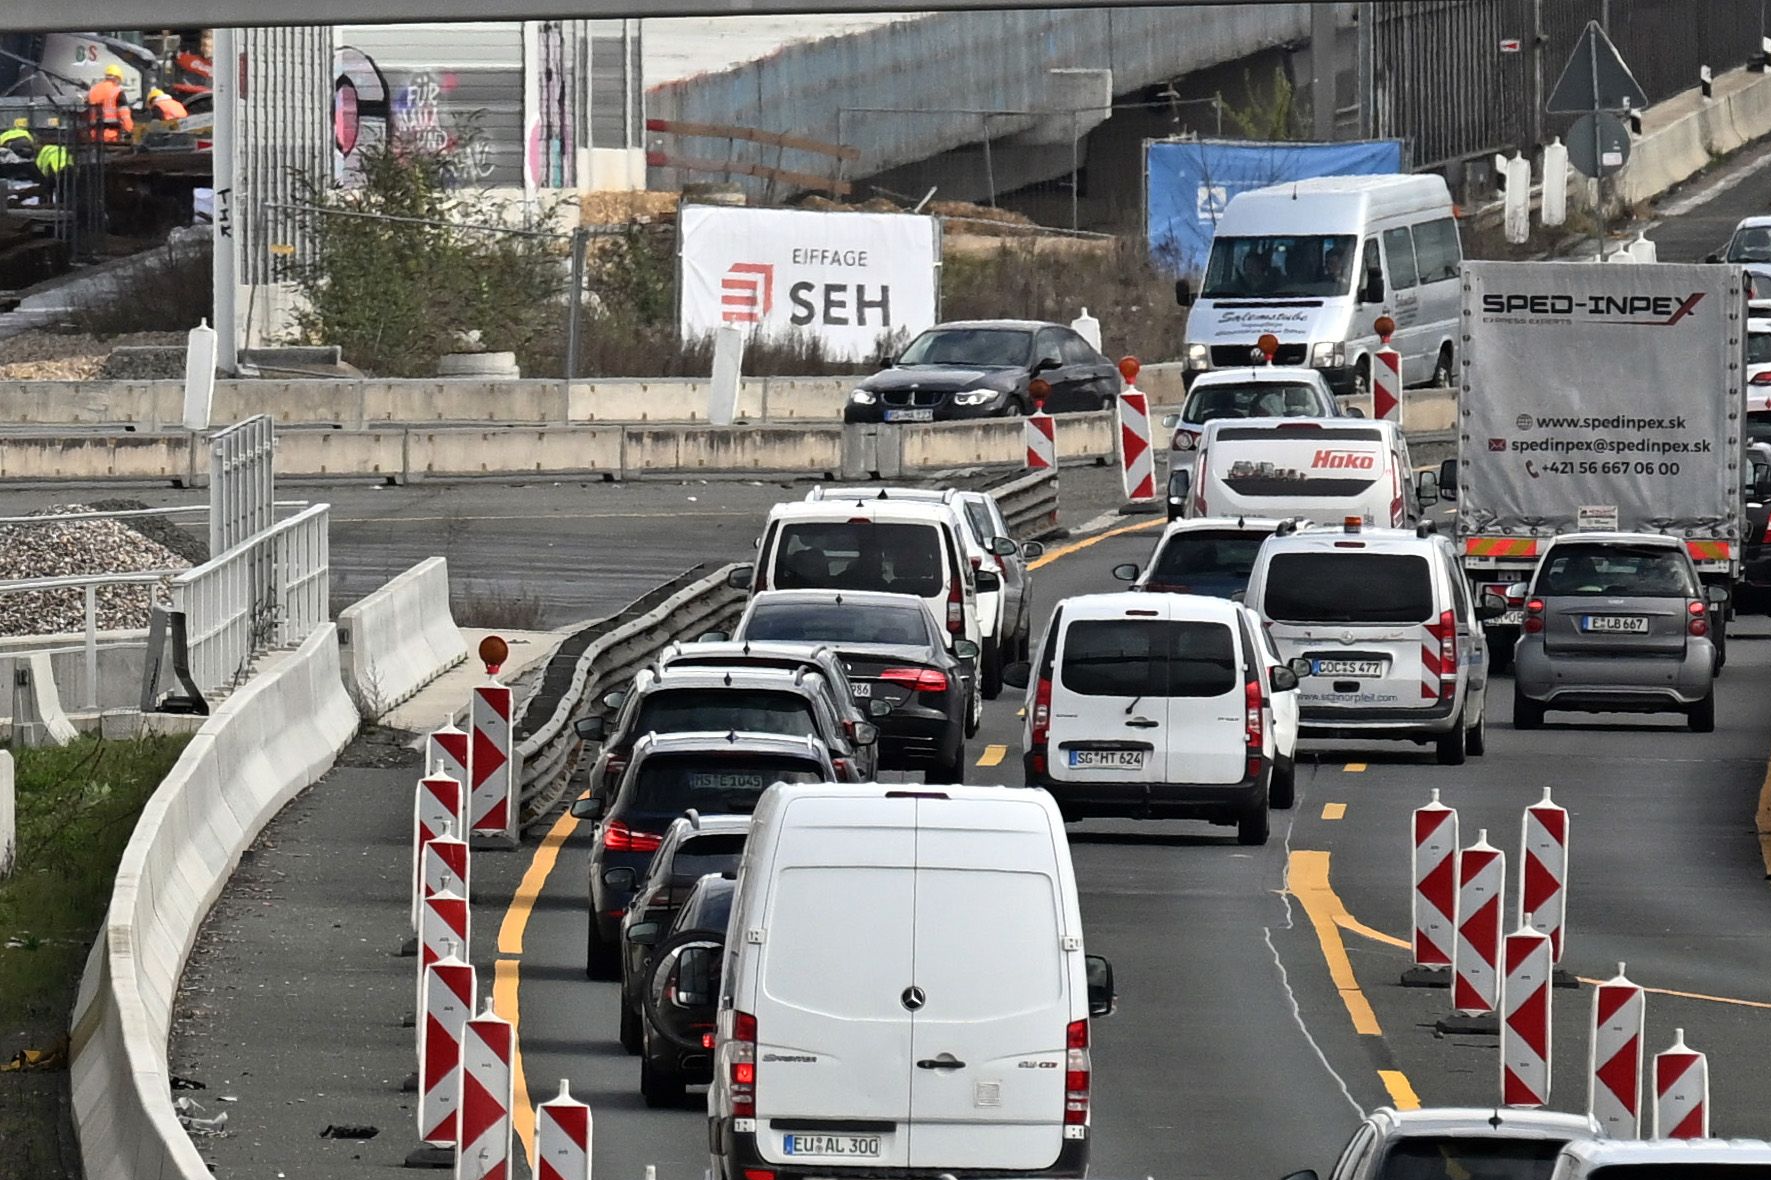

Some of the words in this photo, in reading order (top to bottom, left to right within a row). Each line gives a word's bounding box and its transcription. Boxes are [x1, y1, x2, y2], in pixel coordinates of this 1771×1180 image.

[407, 76, 439, 107] FÜR
[793, 248, 868, 267] EIFFAGE
[789, 281, 890, 327] SEH
[1483, 293, 1706, 318] SPED-INPEX
[1483, 316, 1526, 324] EXPRESS
[1536, 414, 1686, 431] www.spedinpex.sk
[1511, 438, 1711, 455] spedinpex@spedinpex.sk
[1311, 450, 1375, 469] Hako
[1542, 462, 1574, 474] +421
[1579, 462, 1597, 474] 56
[1602, 462, 1630, 474] 667
[1634, 462, 1653, 475] 06
[1658, 463, 1680, 475] 00
[1623, 619, 1643, 630] 667
[1359, 662, 1379, 673] 477
[1119, 753, 1141, 765] 624
[849, 1139, 879, 1153] 300
